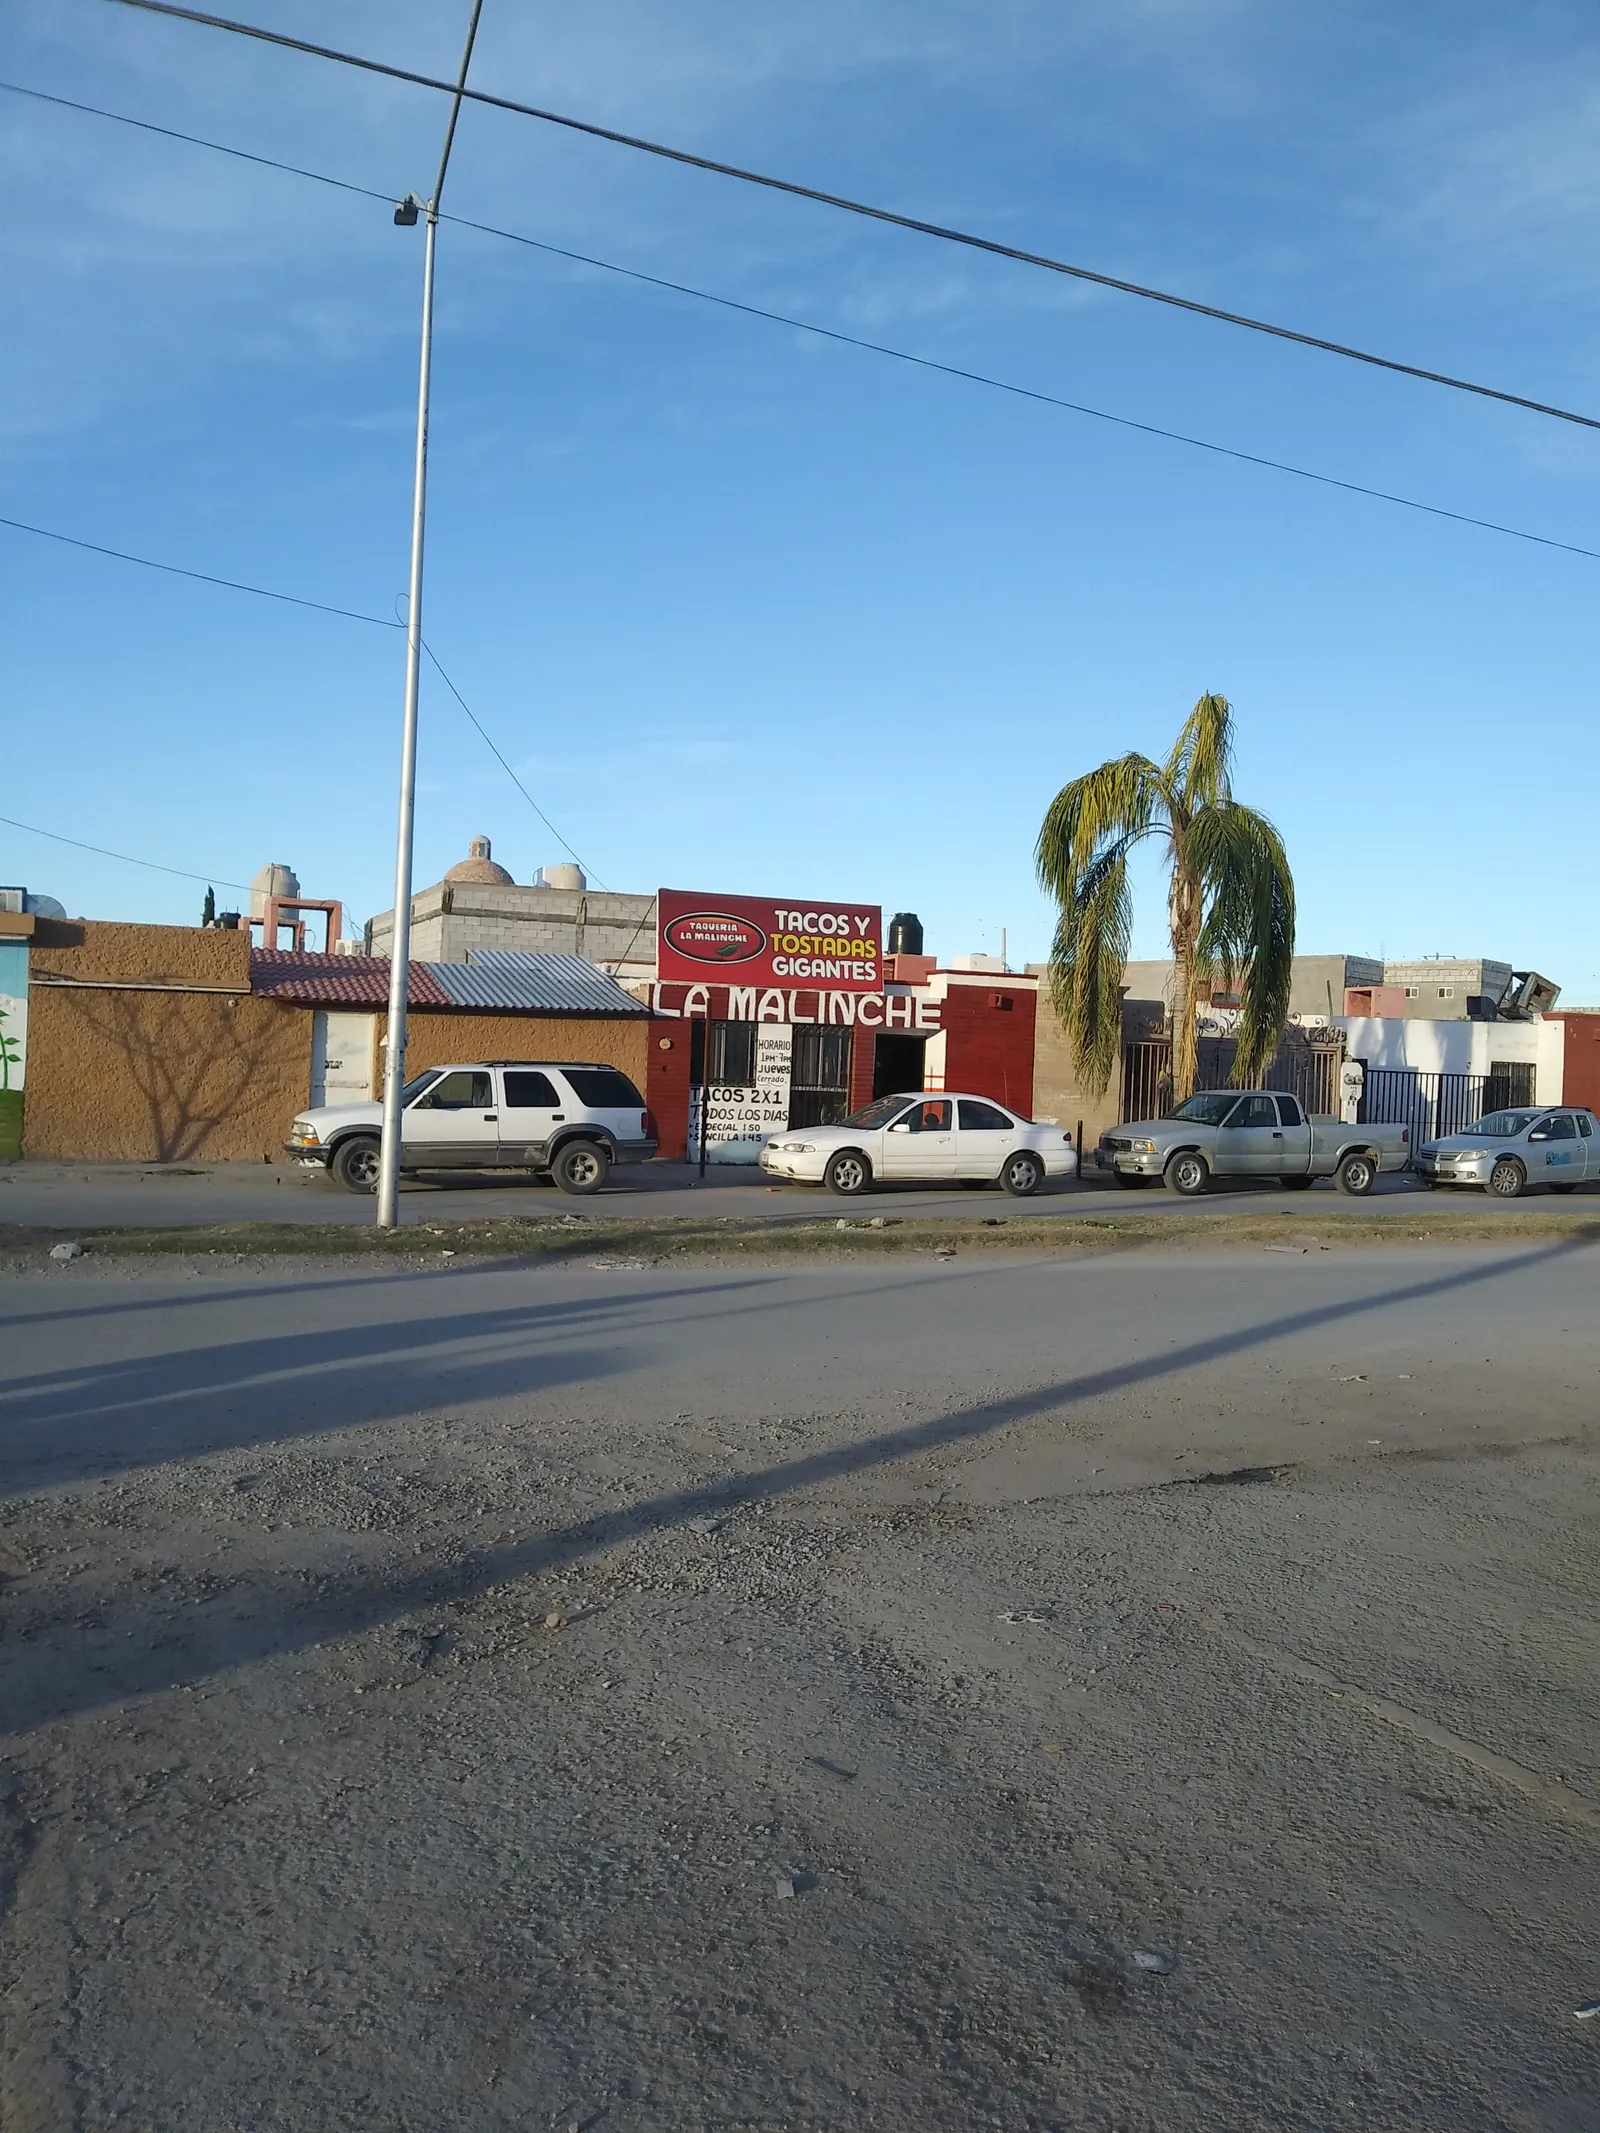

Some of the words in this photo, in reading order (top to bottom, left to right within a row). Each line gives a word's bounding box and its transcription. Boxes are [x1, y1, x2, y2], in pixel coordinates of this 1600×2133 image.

[774, 909, 850, 936] TACOS
[854, 915, 871, 936] Y
[680, 932, 692, 940] LA
[695, 933, 748, 943] MALINCHE
[770, 933, 877, 958] TOSTADAS
[772, 956, 877, 981] GIGANTES
[652, 983, 710, 1019] LA
[727, 986, 942, 1029] MALINCHE
[758, 1039, 791, 1051] HORARIO
[758, 1064, 791, 1074] Jueves
[750, 1089, 783, 1105] 2X1
[737, 1108, 761, 1121] LOS
[763, 1109, 788, 1122] DIAS
[694, 1122, 738, 1132] EPECIAL
[742, 1123, 761, 1132] $50
[693, 1132, 739, 1142] SNCILLA
[741, 1133, 762, 1143] $45
